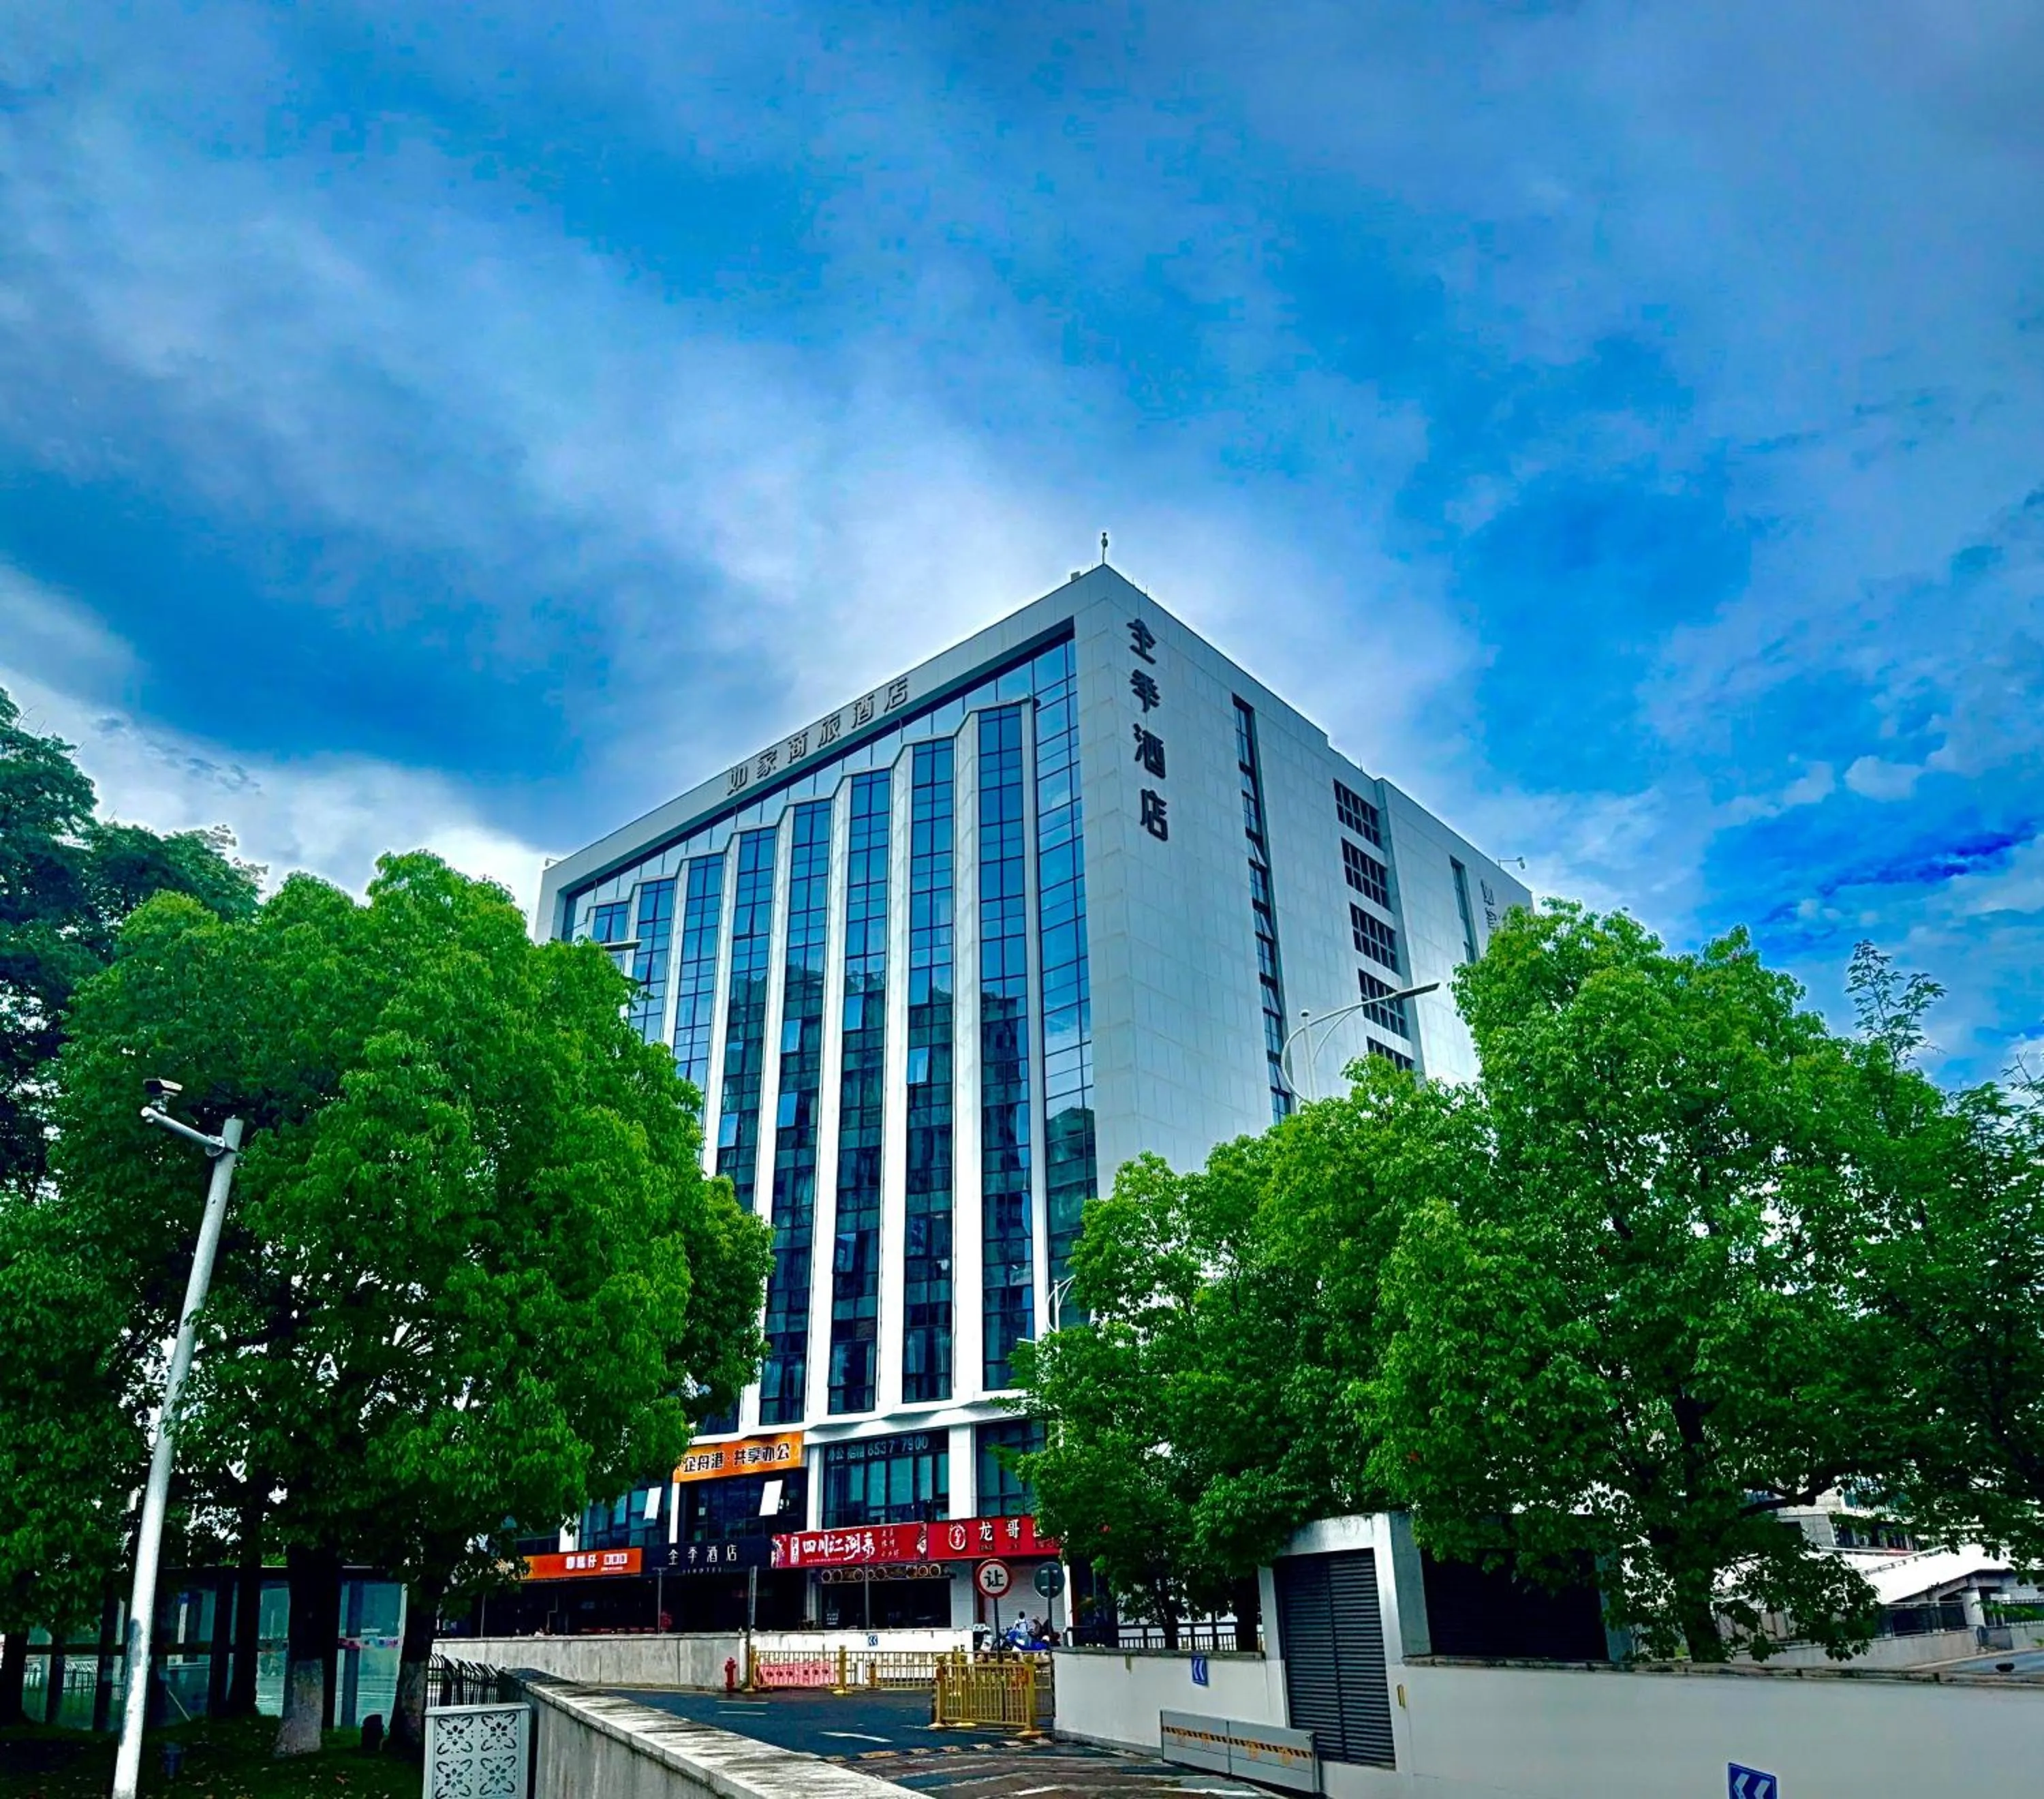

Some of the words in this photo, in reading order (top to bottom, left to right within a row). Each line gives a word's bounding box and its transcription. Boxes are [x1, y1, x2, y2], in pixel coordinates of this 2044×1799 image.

[727, 678, 908, 796] 如家商旅酒店
[1126, 618, 1168, 842] 全季酒店
[668, 1543, 737, 1565] 全季酒店
[984, 1569, 1004, 1588] 让
